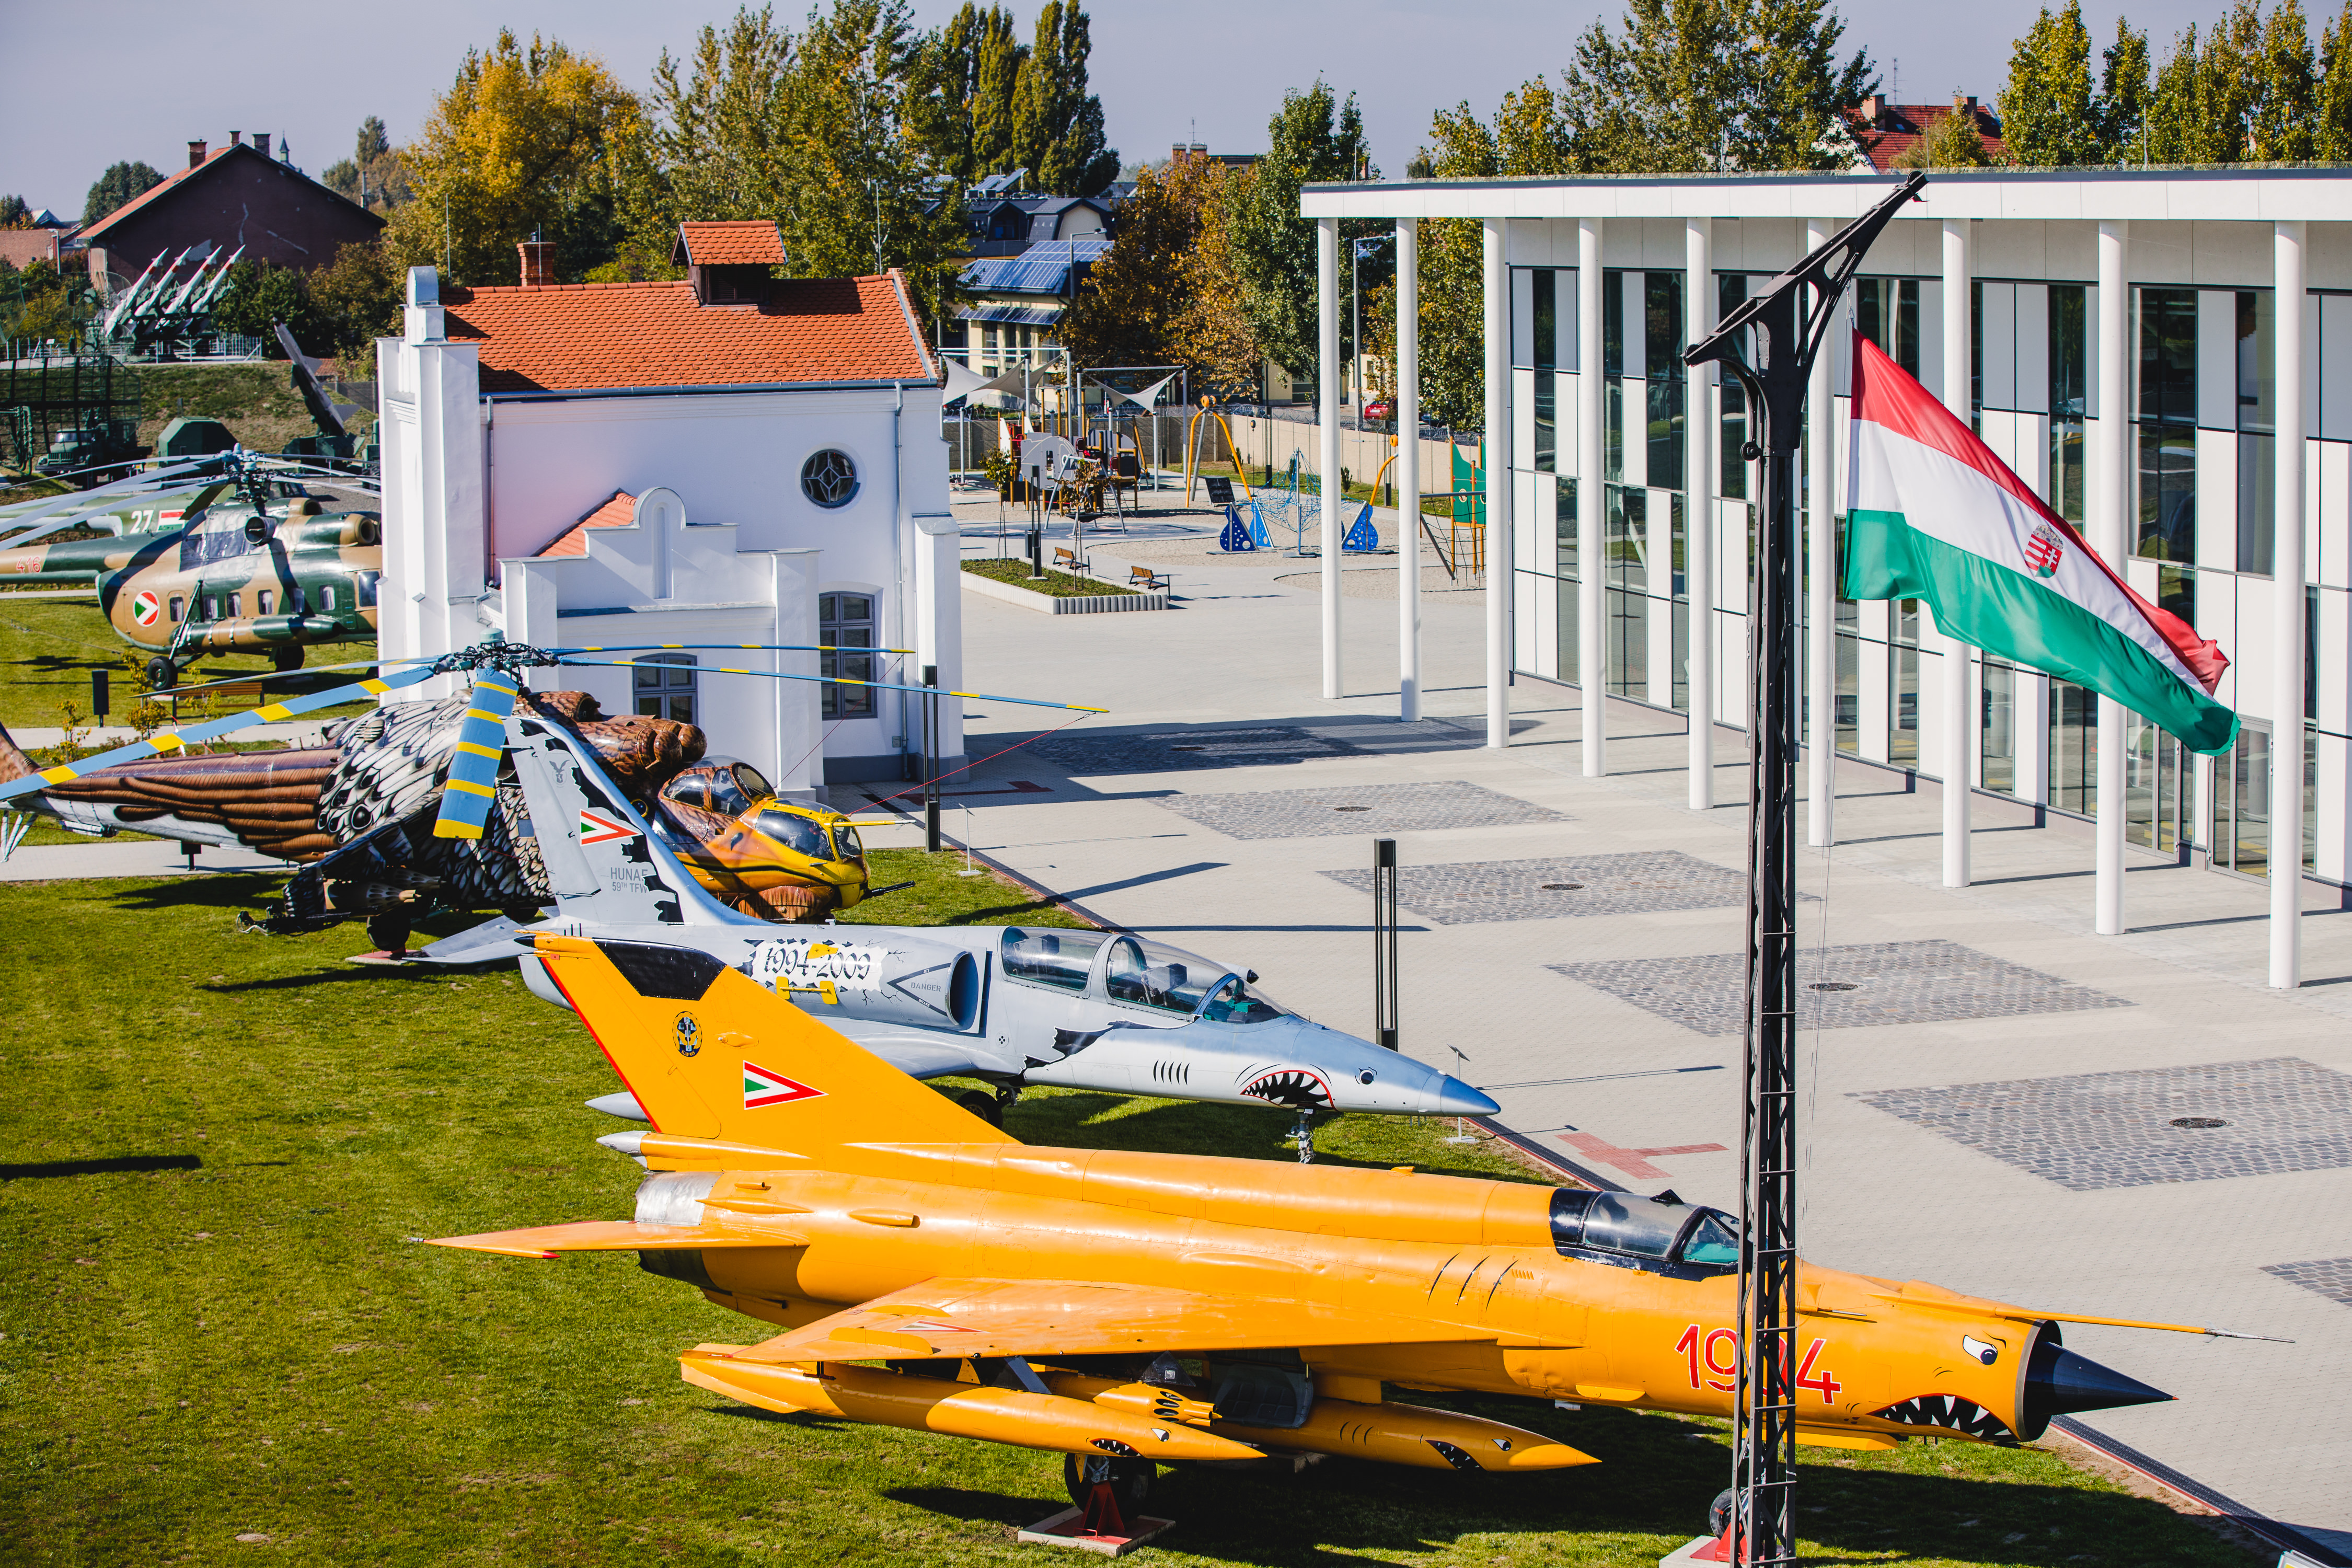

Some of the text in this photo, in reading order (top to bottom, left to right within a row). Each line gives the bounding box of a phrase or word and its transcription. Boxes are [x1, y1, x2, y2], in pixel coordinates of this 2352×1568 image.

[130, 510, 154, 534] 27
[16, 556, 41, 573] 416
[629, 883, 648, 893] TFW
[764, 947, 871, 980] 1994-2009
[910, 982, 941, 992] DANGER
[918, 998, 930, 1008] INTAKE
